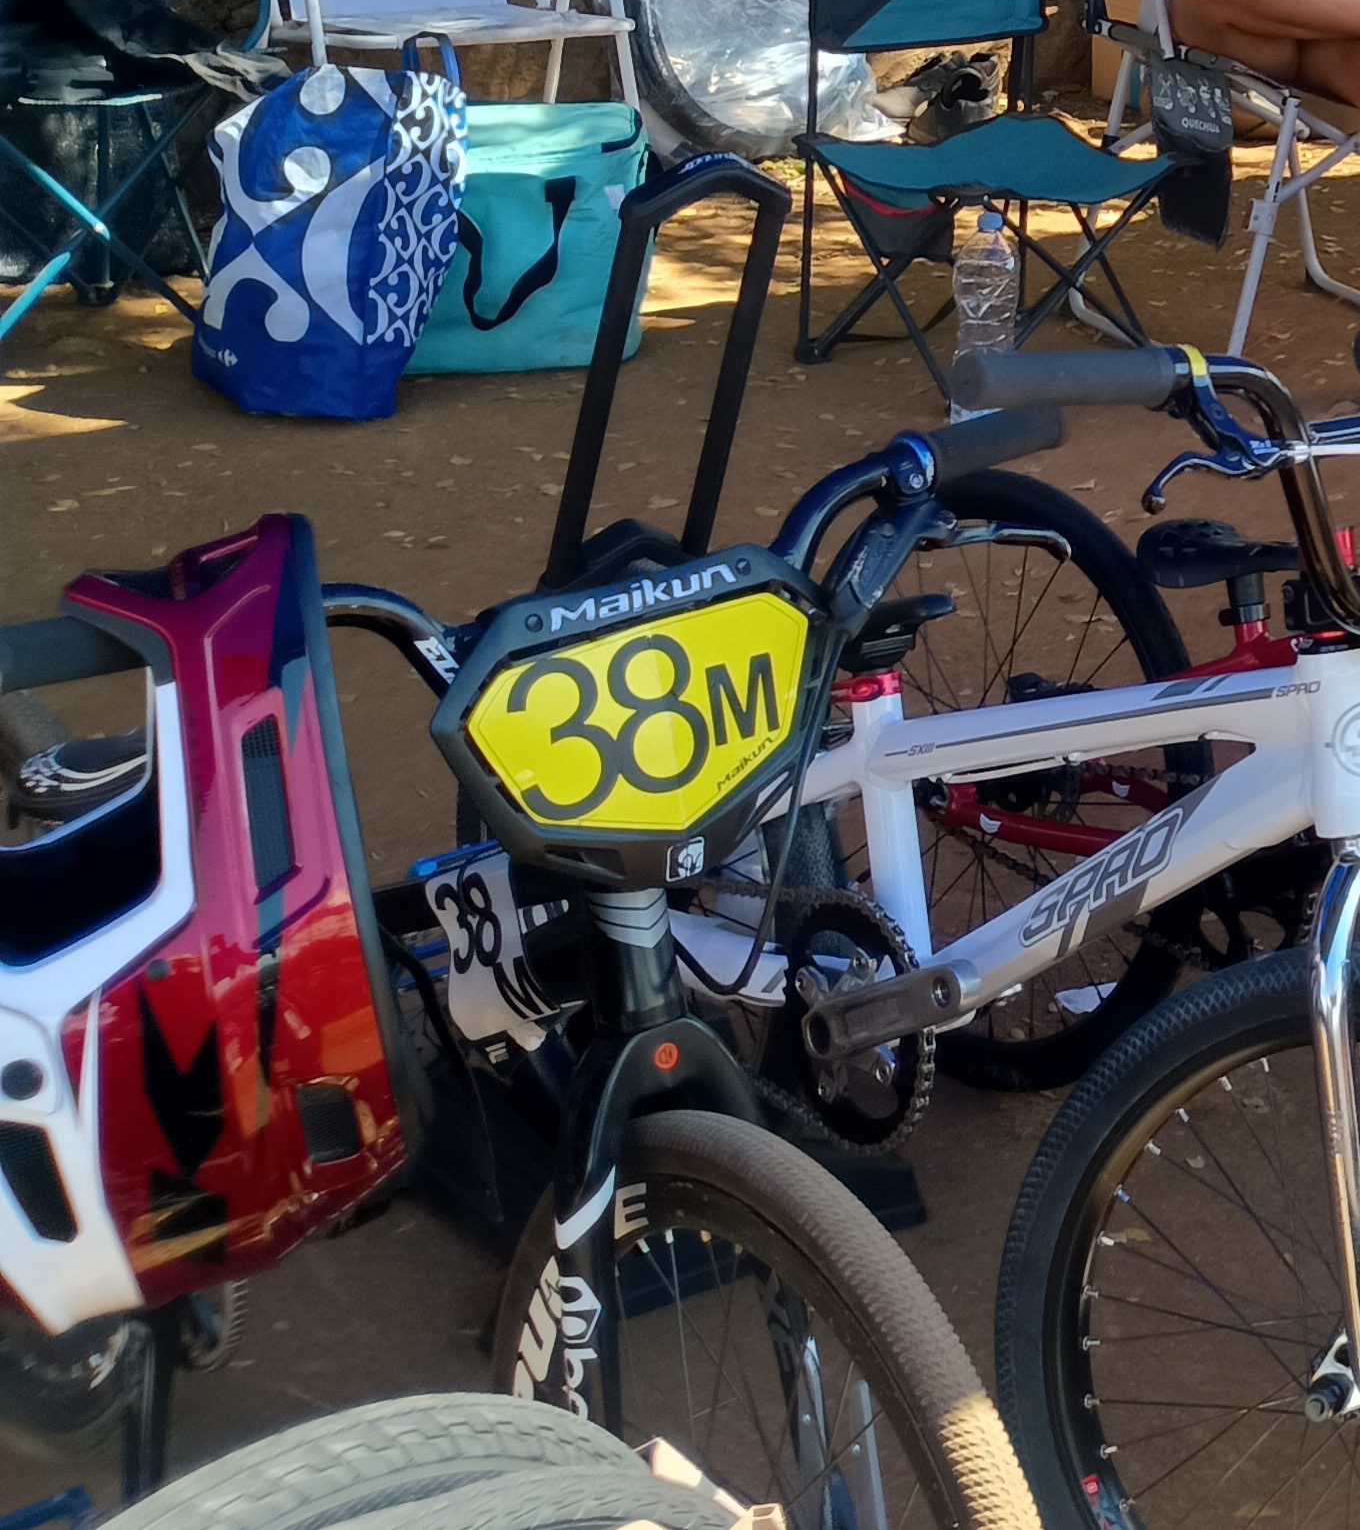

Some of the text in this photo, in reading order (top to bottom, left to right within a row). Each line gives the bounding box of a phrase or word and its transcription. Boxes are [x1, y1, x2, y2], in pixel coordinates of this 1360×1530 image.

[1181, 116, 1220, 135] QUECHUA
[549, 563, 738, 633] Maikun
[715, 736, 775, 793] Maikun
